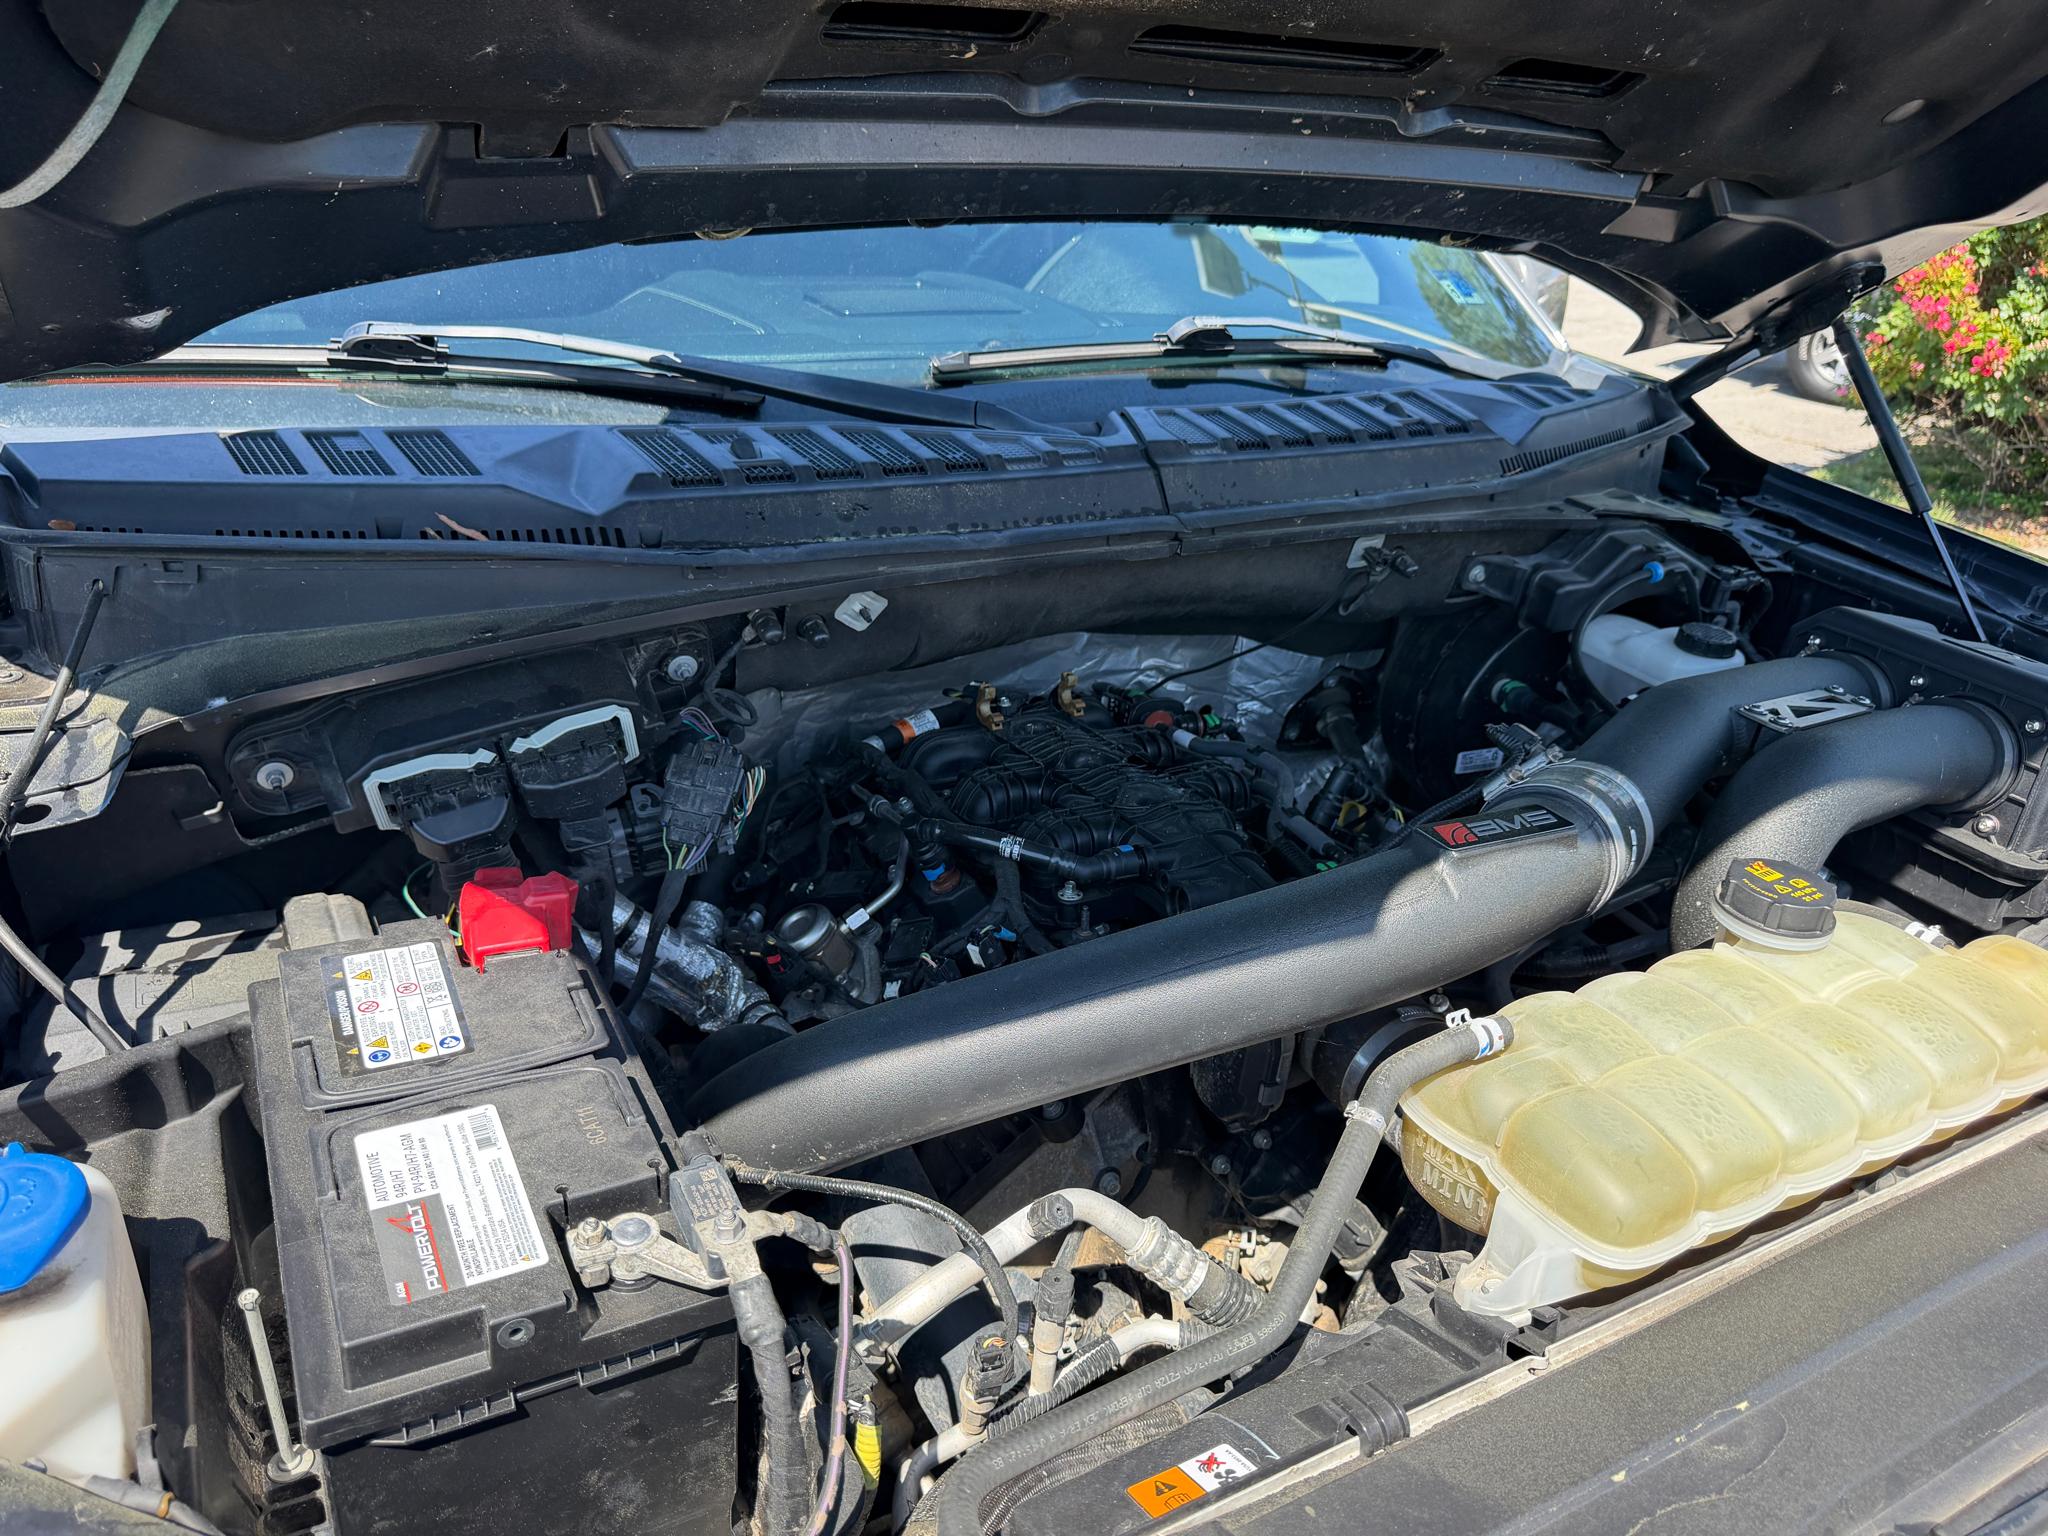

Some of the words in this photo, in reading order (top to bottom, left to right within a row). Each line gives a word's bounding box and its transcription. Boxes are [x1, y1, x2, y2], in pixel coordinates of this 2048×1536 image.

[335, 989, 353, 1036] DANGER/POISON
[365, 1151, 390, 1203] AUTOMOTIVE
[398, 1132, 428, 1194] PV-94R/H7-AGM
[1425, 1137, 1476, 1182] MAX
[389, 1167, 409, 1198] 94R/H7
[430, 1178, 439, 1189] CCA
[1422, 1161, 1476, 1209] MIN
[445, 1202, 463, 1238] REPLACEMENT
[405, 1200, 443, 1291] POWERVOLT
[456, 1237, 467, 1251] FREE
[465, 1238, 484, 1276] NONSPILLABLE
[395, 1281, 407, 1298] AGM
